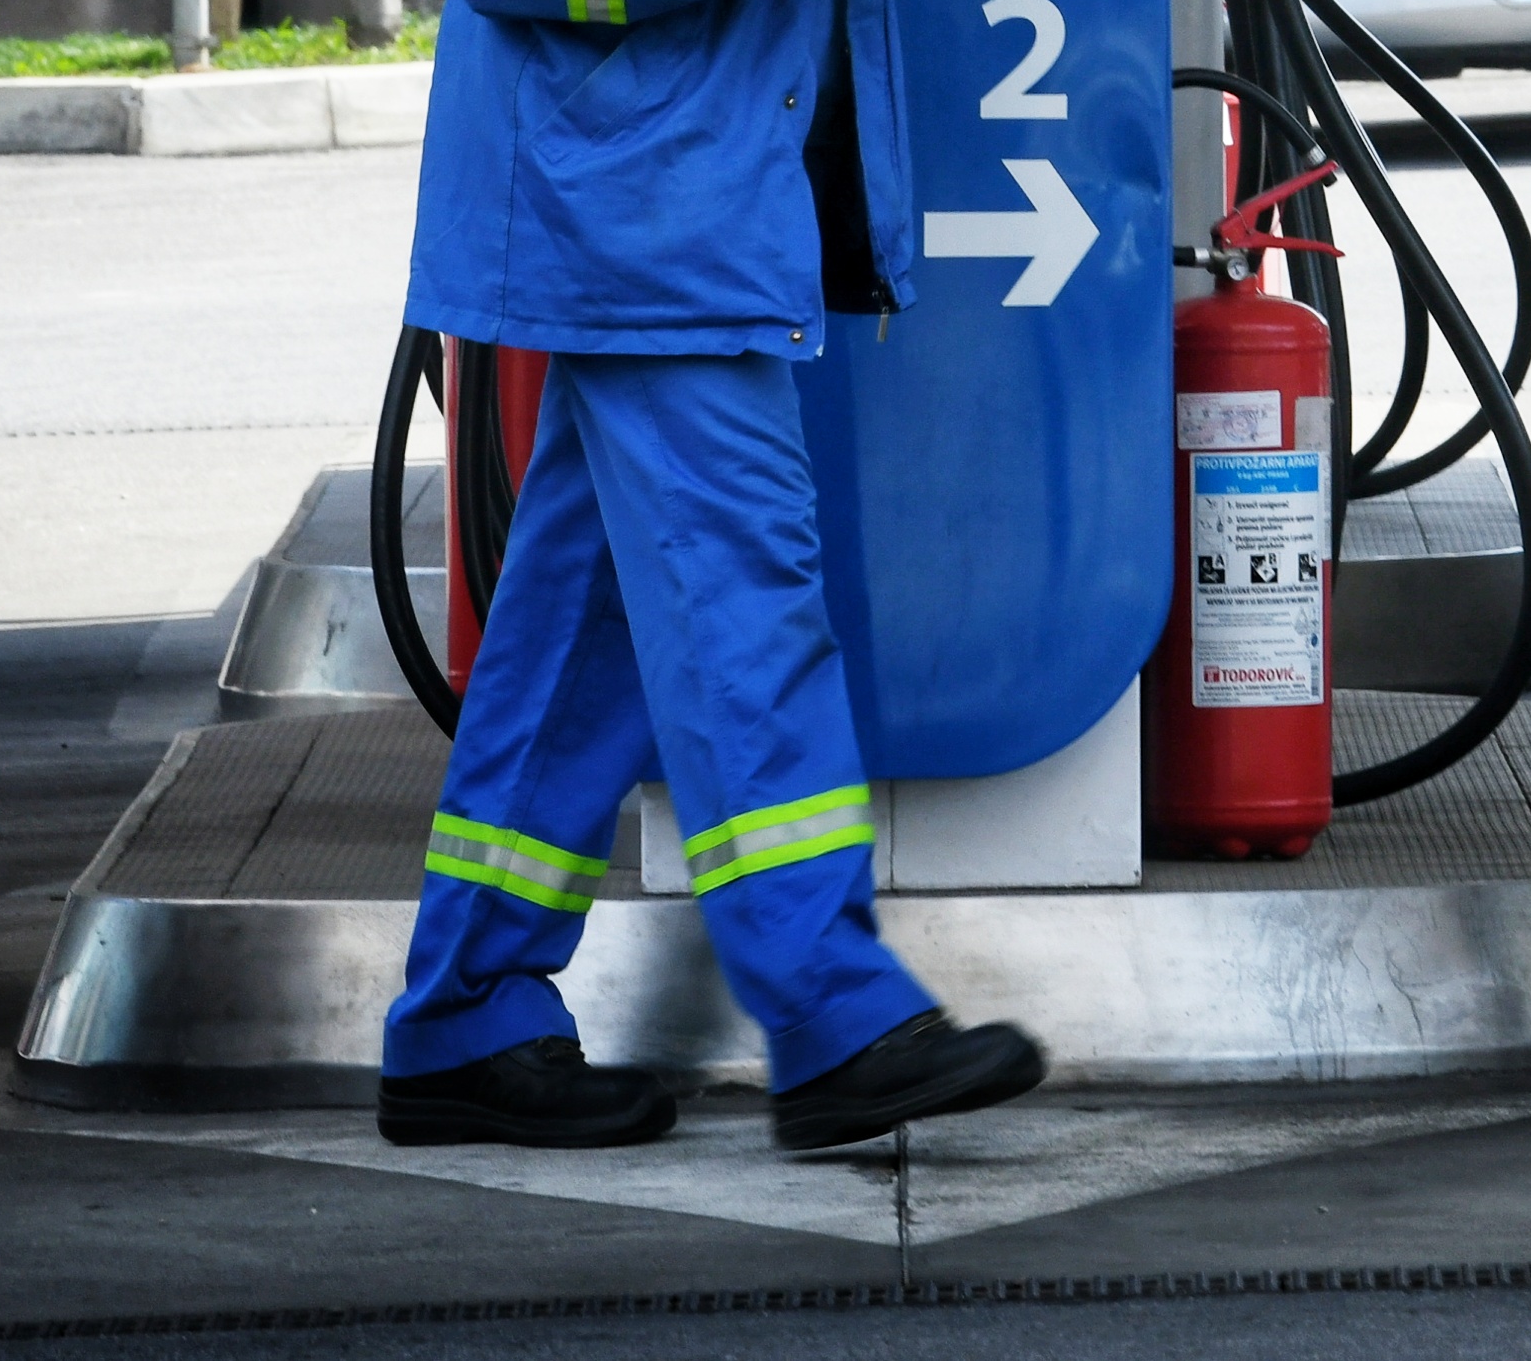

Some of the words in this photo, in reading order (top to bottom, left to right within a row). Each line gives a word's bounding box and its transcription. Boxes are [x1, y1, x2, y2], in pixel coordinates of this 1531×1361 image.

[1214, 552, 1225, 567] A
[1268, 552, 1278, 566] B
[1221, 663, 1295, 683] TODOROVIĆ
